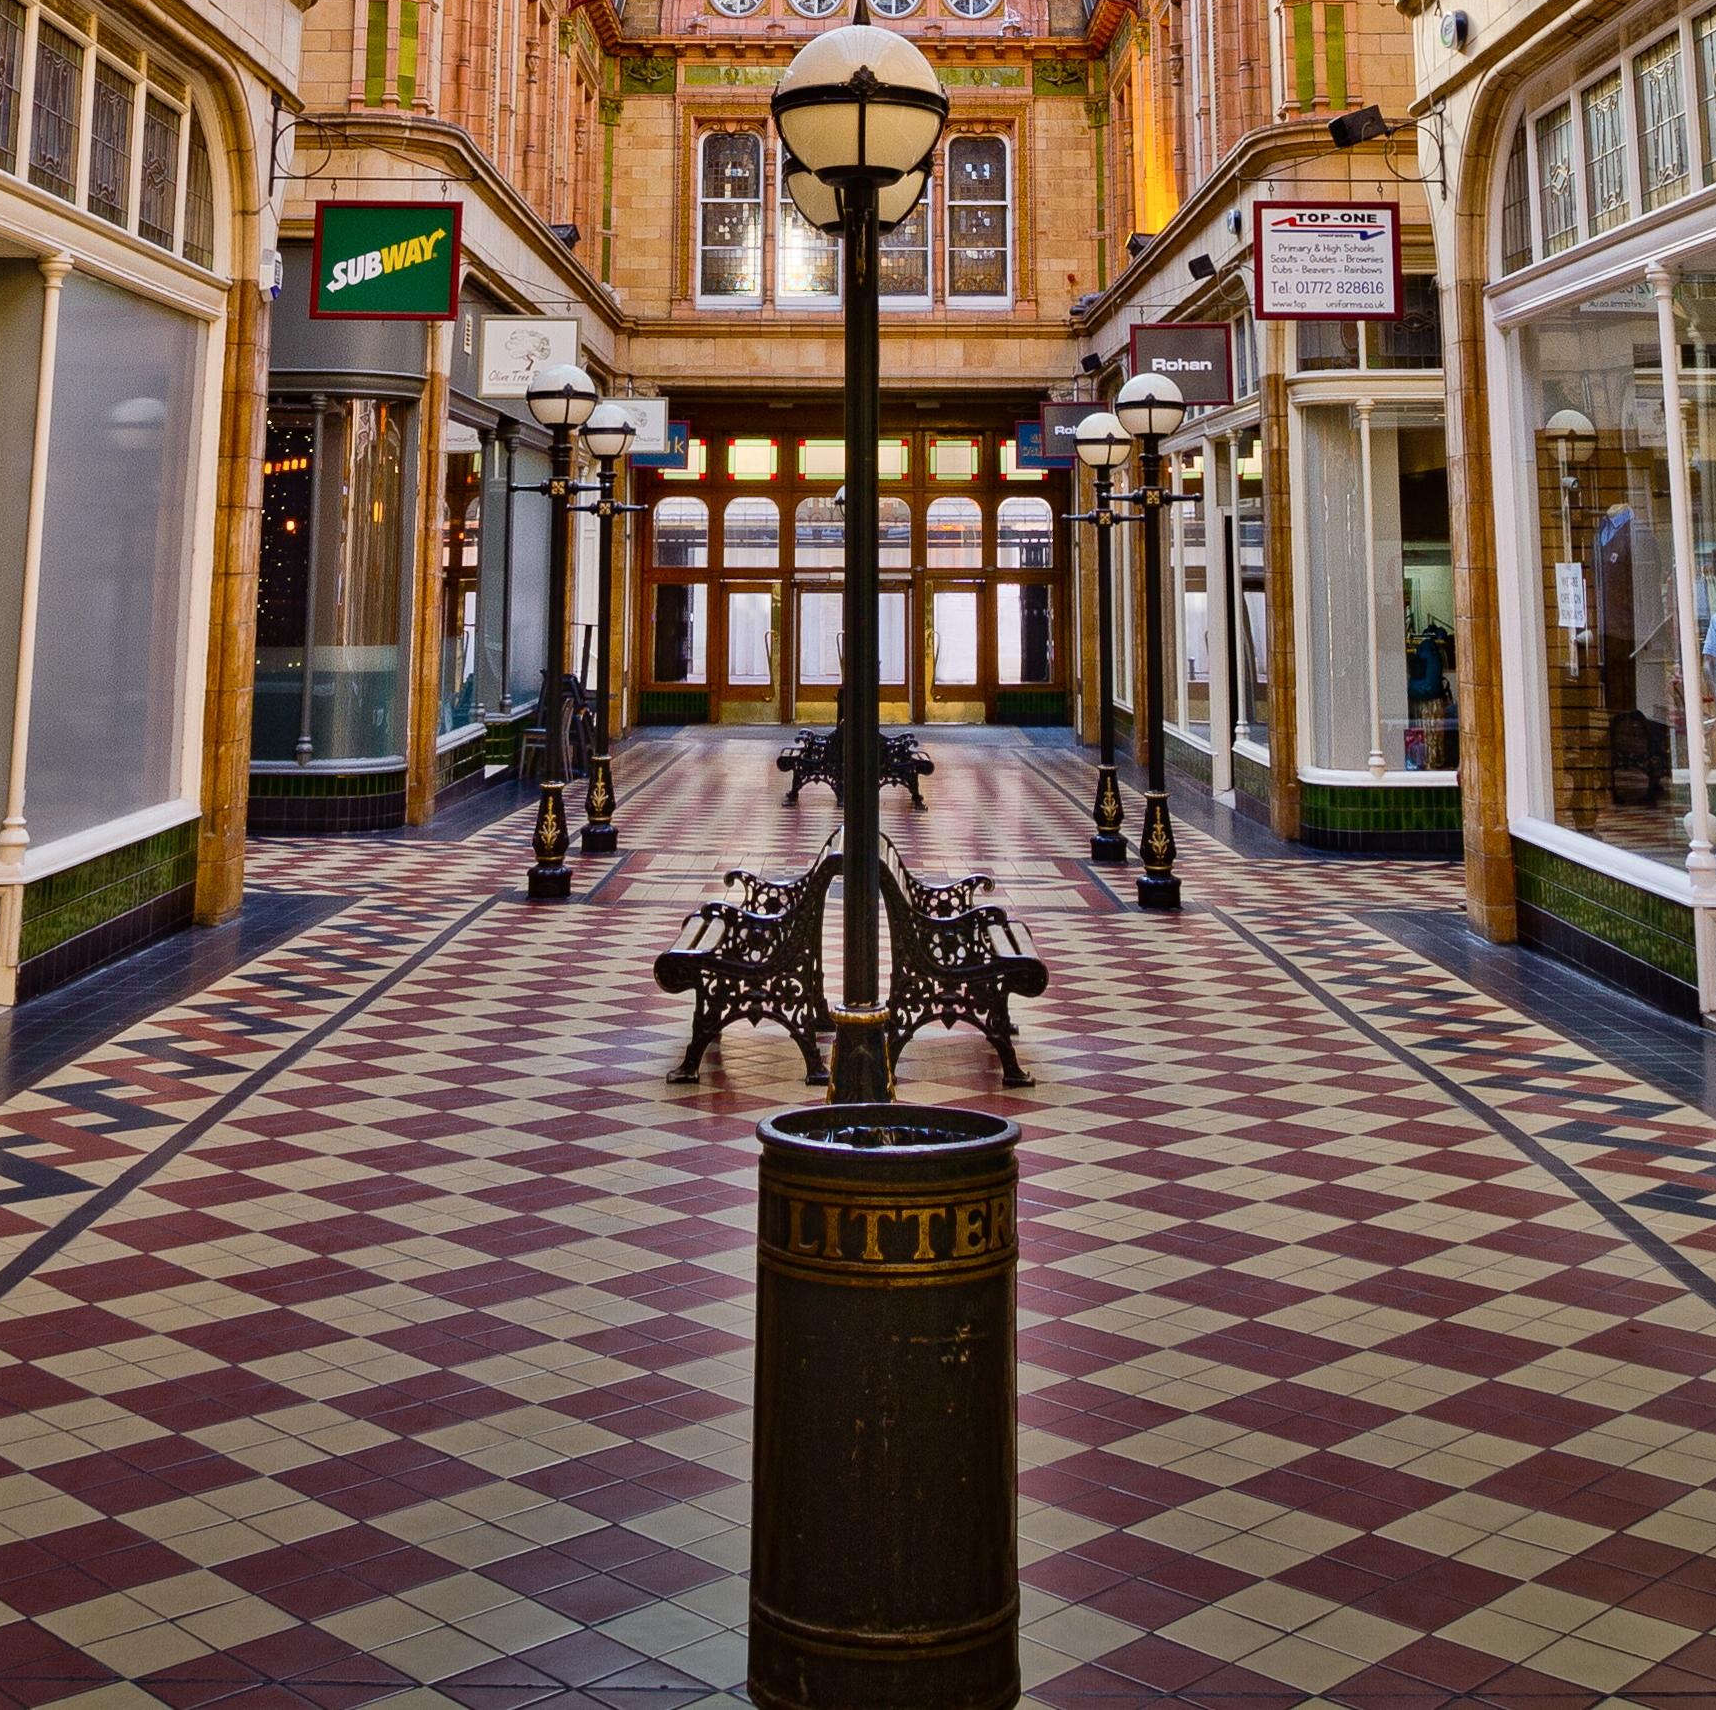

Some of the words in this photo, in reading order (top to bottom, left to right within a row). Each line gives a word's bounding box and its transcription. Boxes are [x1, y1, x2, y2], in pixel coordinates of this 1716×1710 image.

[1278, 243, 1312, 253] Primary
[1323, 244, 1341, 254] High
[1344, 244, 1375, 253] Schools
[325, 228, 447, 293] SUBWAY
[1270, 254, 1298, 263] Scouts
[1346, 255, 1384, 263] Brownies
[1272, 265, 1293, 274] Cubs
[1302, 265, 1335, 274] Beavers
[1344, 265, 1383, 274] Rainbows
[1295, 281, 1332, 294] 01772
[1336, 281, 1384, 294] 828616
[1151, 358, 1213, 372] Rohan
[489, 370, 510, 382] Olive
[512, 370, 531, 381] Tree
[788, 1196, 1012, 1260] LITTER
